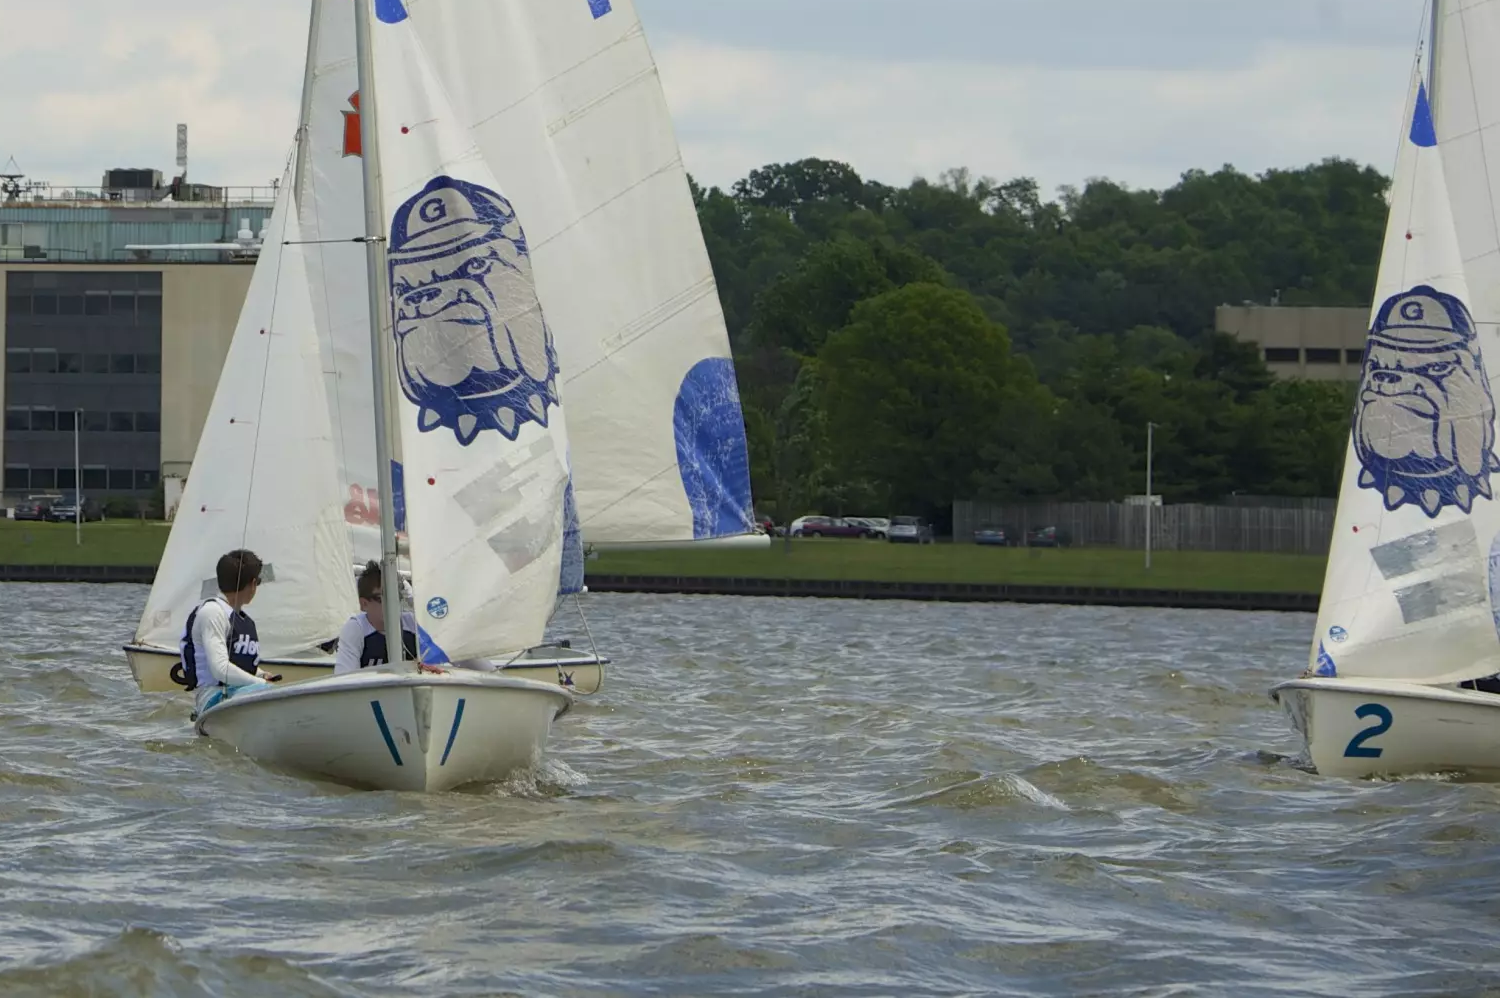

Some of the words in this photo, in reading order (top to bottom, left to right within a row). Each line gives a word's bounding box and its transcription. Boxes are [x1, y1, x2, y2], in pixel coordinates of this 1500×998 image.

[419, 197, 446, 223] G
[1400, 301, 1424, 321] G
[1343, 703, 1393, 758] 2
